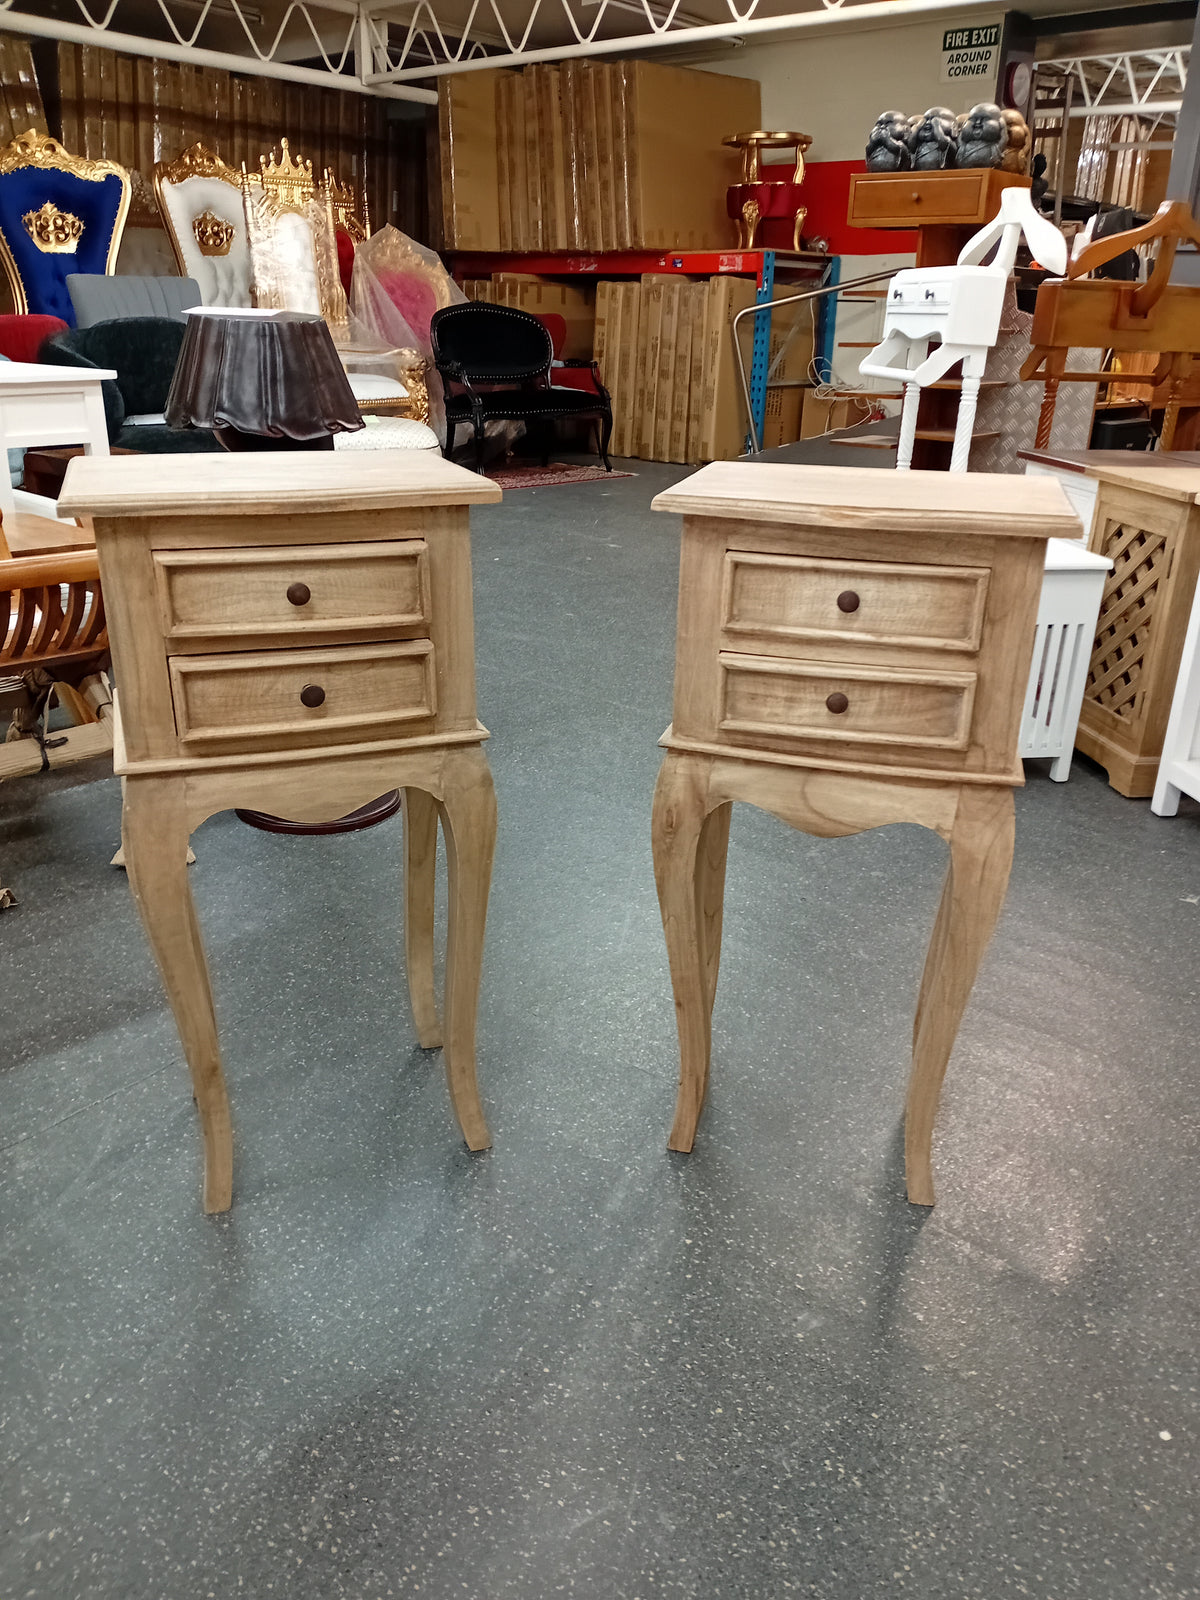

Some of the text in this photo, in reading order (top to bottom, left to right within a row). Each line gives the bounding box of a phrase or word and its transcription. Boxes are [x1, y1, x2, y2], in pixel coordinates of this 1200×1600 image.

[945, 28, 997, 48] FIRE EXIT
[947, 50, 991, 64] AROUND
[948, 64, 988, 77] CORNER
